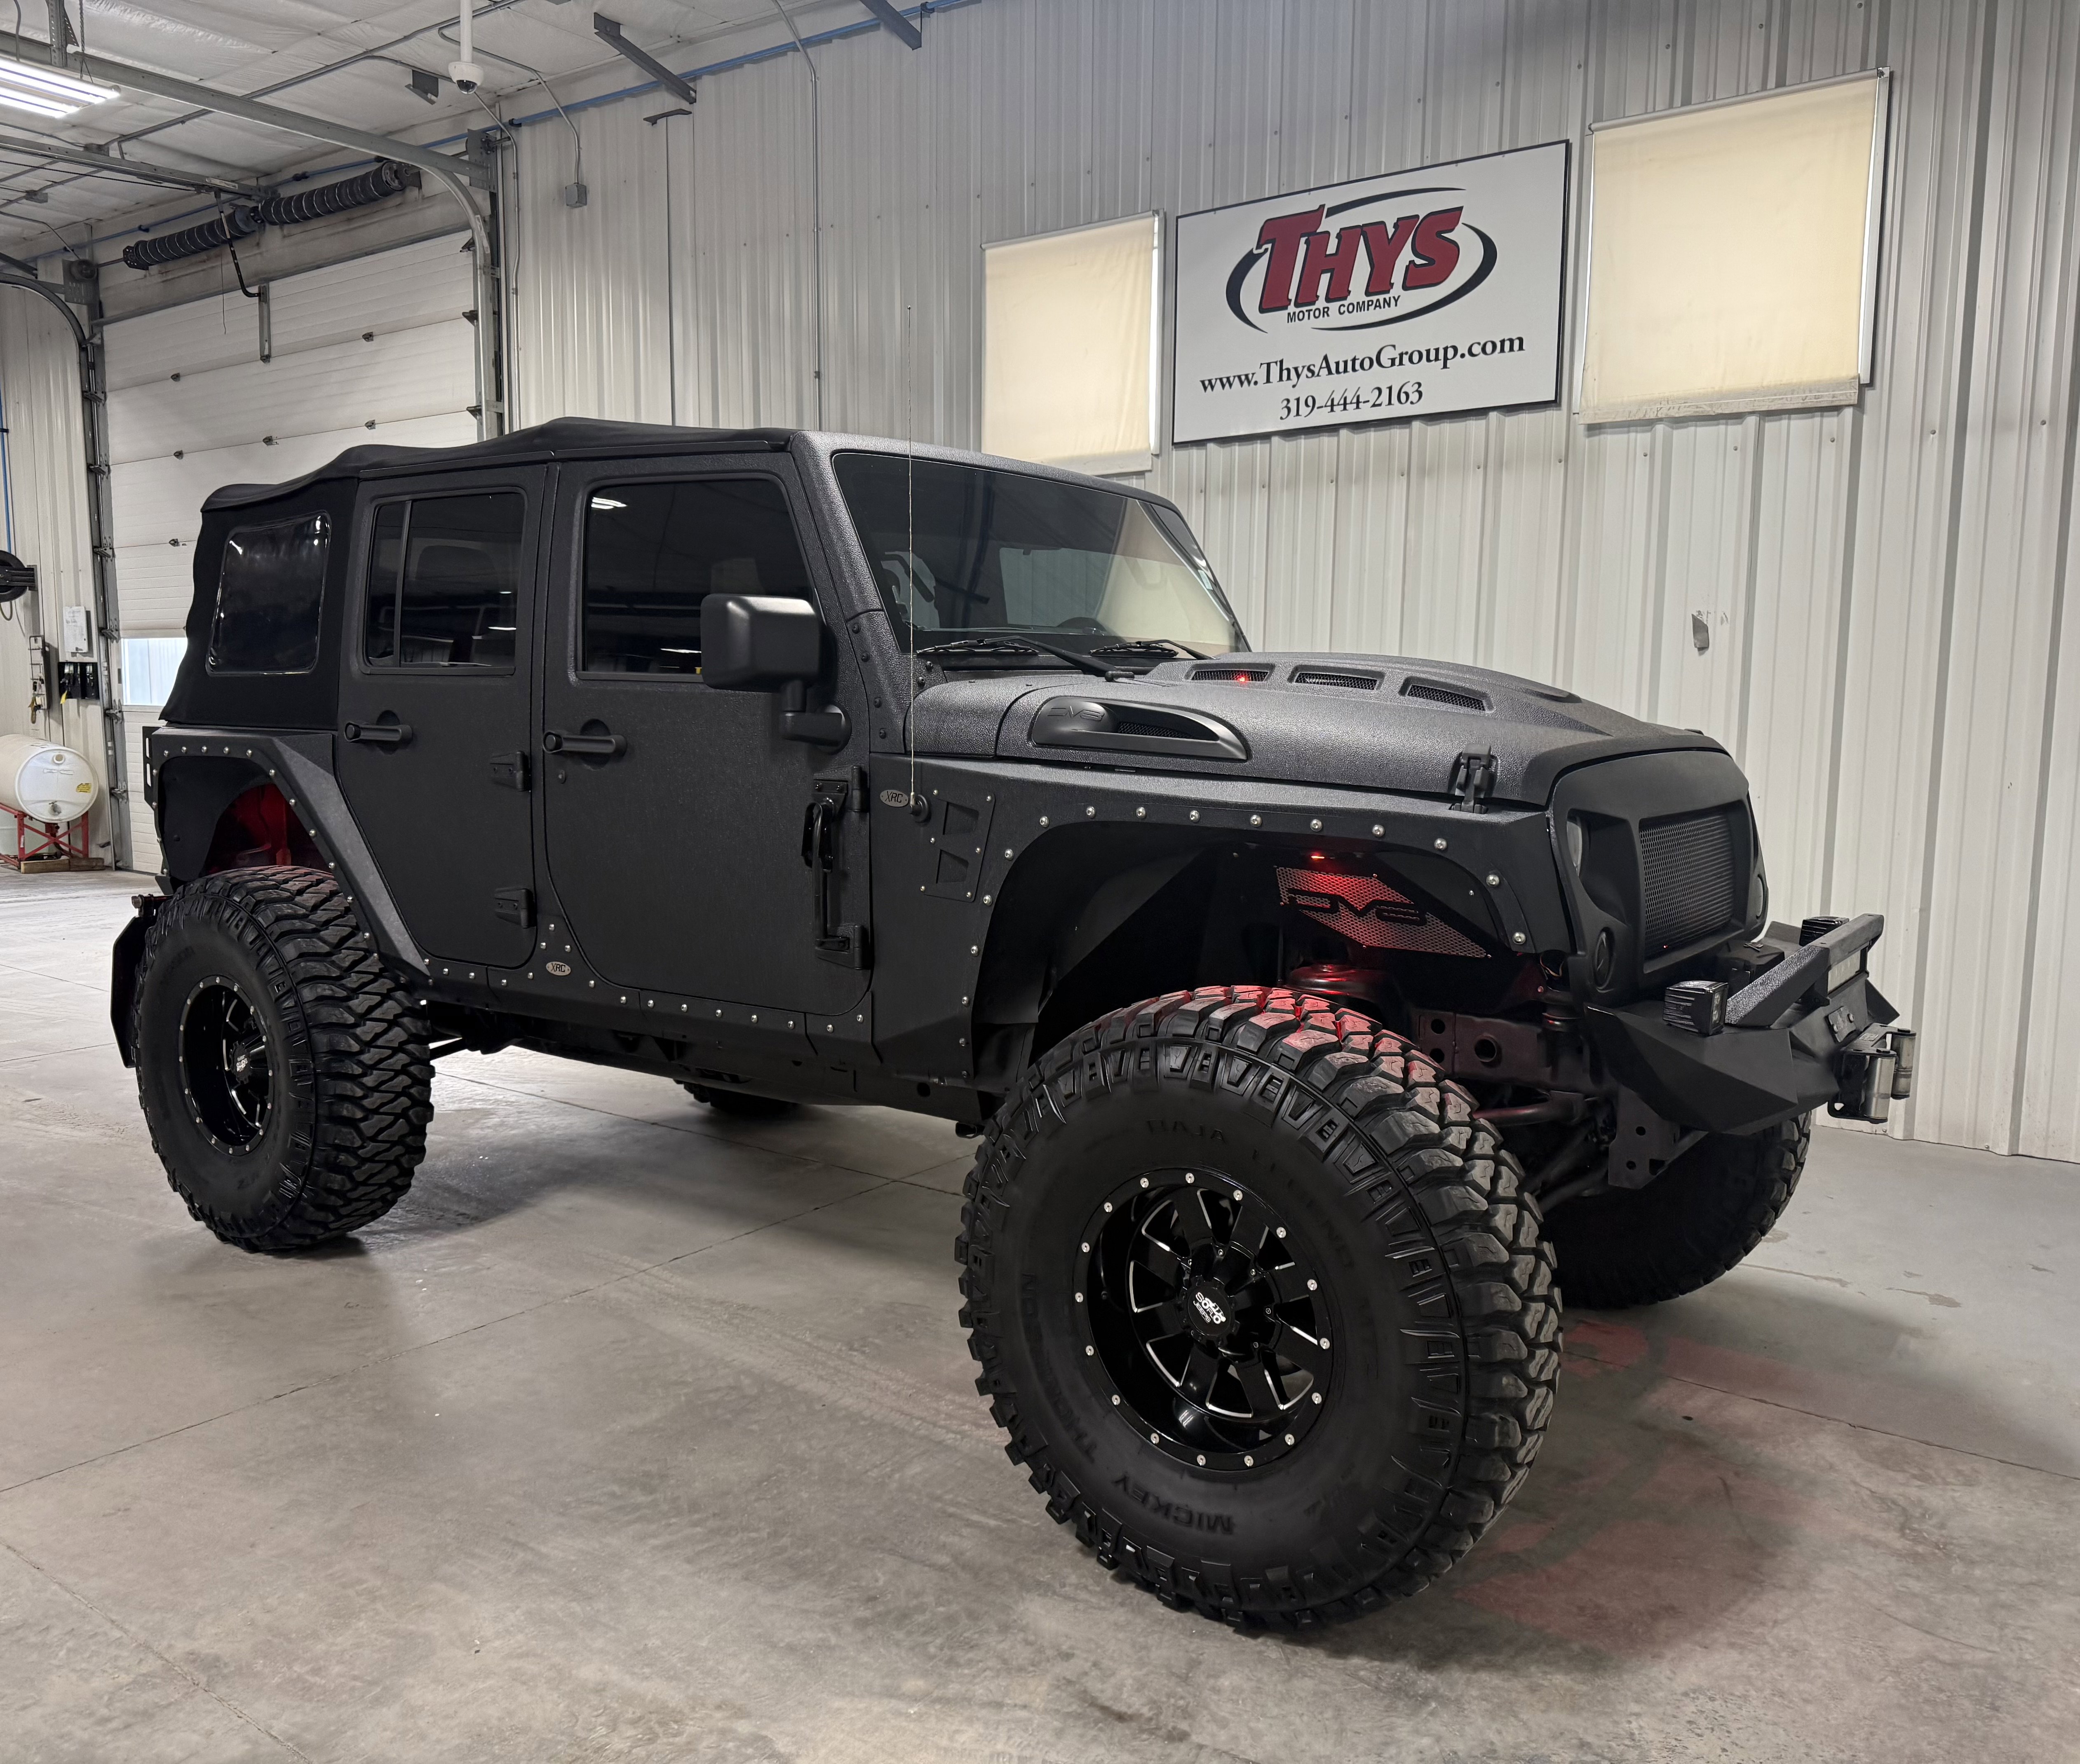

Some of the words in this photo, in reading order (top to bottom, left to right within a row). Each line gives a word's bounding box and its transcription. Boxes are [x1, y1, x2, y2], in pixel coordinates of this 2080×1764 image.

[1256, 204, 1463, 314] THYS
[1287, 305, 1330, 324] MOTOR
[1338, 295, 1401, 316] COMPANY
[1200, 336, 1524, 393] www.ThysAutoGroup.com
[1279, 381, 1424, 420] 319-444-2163
[884, 791, 903, 803] XRC
[550, 962, 566, 972] XRC
[1110, 1471, 1237, 1535] MICKEY
